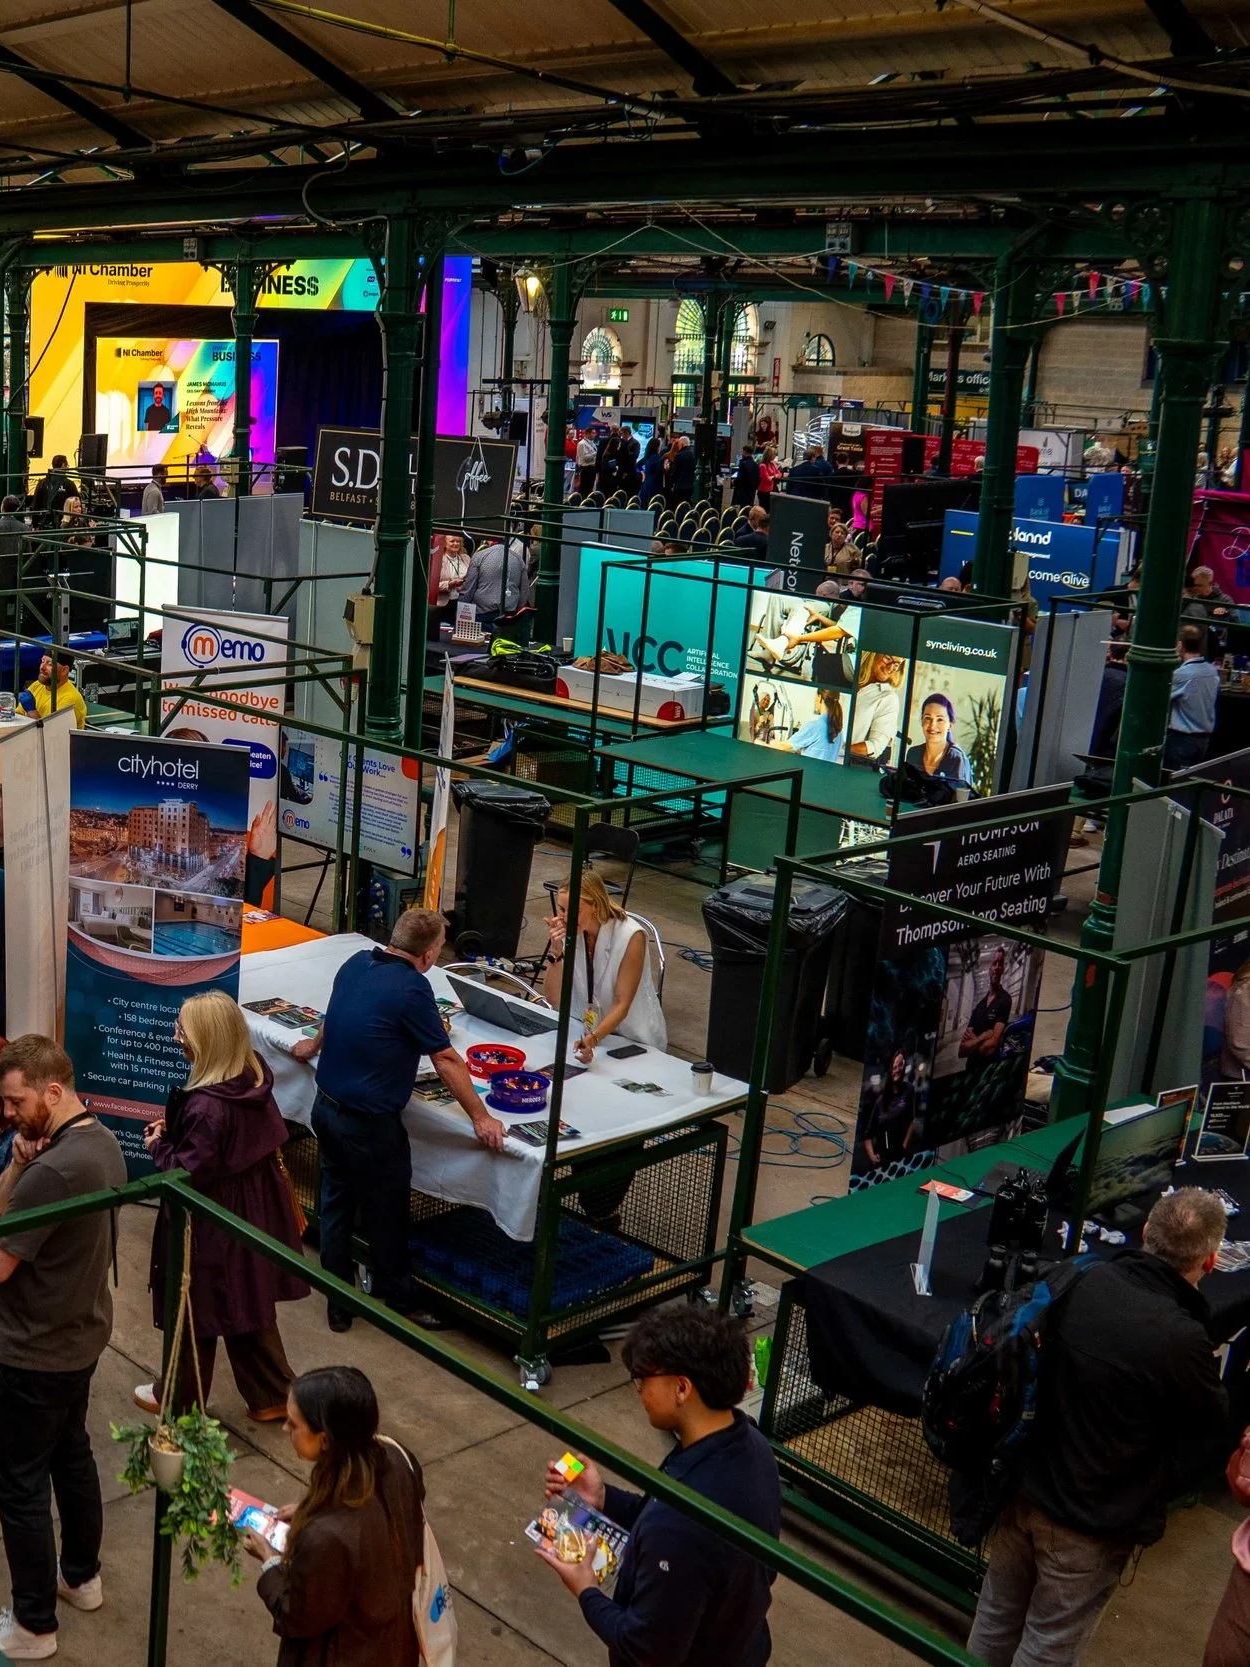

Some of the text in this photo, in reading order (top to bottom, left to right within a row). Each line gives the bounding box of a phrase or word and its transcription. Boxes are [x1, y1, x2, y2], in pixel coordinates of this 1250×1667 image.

[90, 264, 153, 278] Chamber
[212, 352, 262, 362] BUSISS
[329, 491, 368, 505] BELFAST
[1028, 569, 1091, 588] come alive
[926, 640, 998, 659] syncliving.co.uk
[686, 655, 730, 670] INTELLGENCE
[180, 703, 237, 721] missed
[249, 760, 262, 769] ice!
[250, 752, 271, 760] eaten
[118, 754, 199, 779] cityhotel
[378, 761, 396, 773] Love
[177, 781, 199, 790] DERRY
[961, 821, 1039, 846] THOMPSON
[957, 844, 1016, 867] AERO SEATING
[956, 881, 982, 899] Your
[985, 873, 1020, 893] Future
[1024, 862, 1051, 883] With
[896, 918, 964, 946] Thompson
[1000, 895, 1047, 919] Seating
[113, 997, 180, 1014] City centre locat
[124, 1014, 174, 1028] 158 bedroom
[98, 1025, 174, 1043] Conference & even
[107, 1036, 184, 1056] for up to 400 peop
[107, 1050, 134, 1063] Health
[137, 1055, 144, 1063] &
[144, 1056, 174, 1069] Fitness
[110, 1062, 187, 1081] with 15 metre pool
[87, 1072, 165, 1093] Secure car parking
